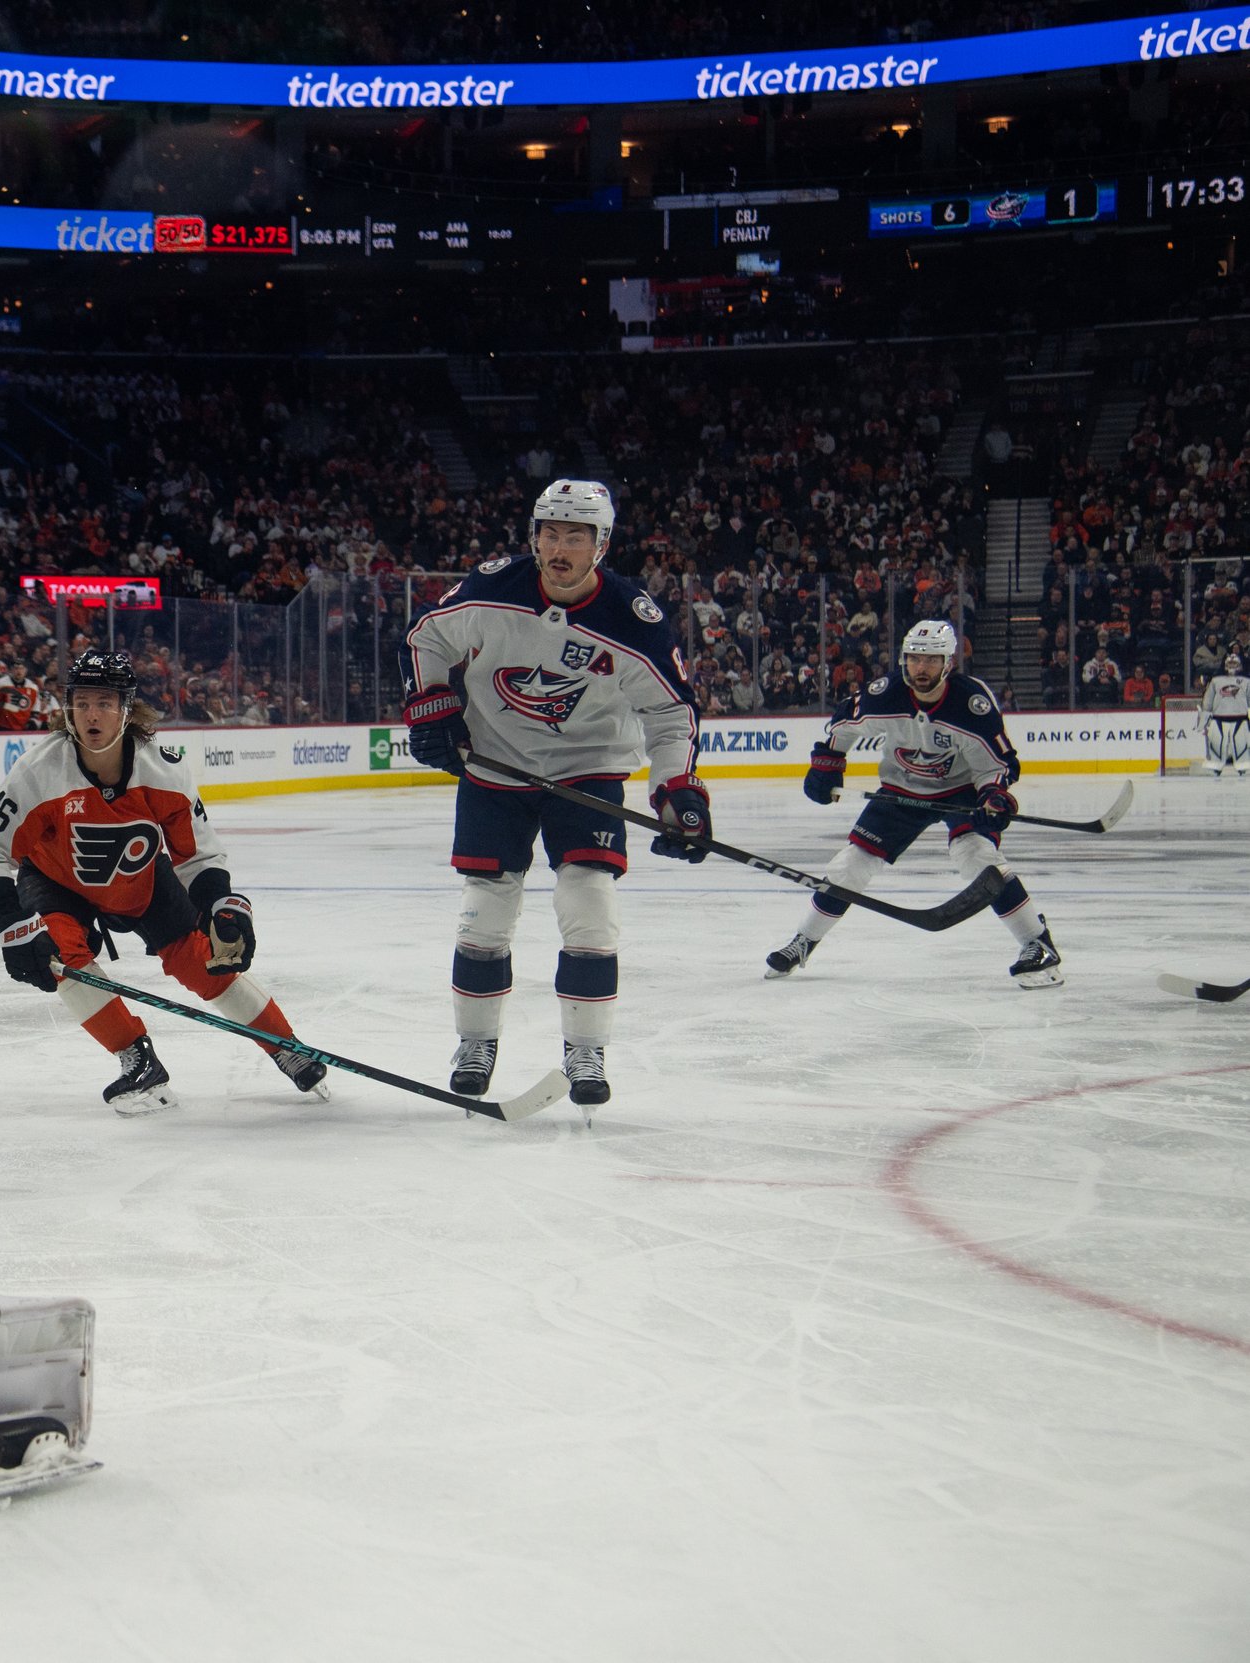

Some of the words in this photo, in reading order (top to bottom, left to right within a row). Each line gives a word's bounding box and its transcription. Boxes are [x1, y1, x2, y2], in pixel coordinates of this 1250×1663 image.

[1138, 16, 1250, 60] ticket
[696, 57, 938, 102] ticketmaster
[288, 74, 513, 109] ticketmaster
[1161, 175, 1245, 209] 17:33
[1063, 189, 1076, 217] 1
[735, 208, 758, 225] CBJ
[880, 210, 922, 225] SHOTS
[943, 203, 956, 222] 6
[211, 225, 288, 246] $21,375
[336, 229, 361, 244] PM
[446, 222, 469, 233] ANA
[722, 225, 771, 243] PENALTY
[49, 584, 111, 601] TACOMA
[917, 629, 929, 637] 19
[87, 656, 104, 666] 46
[564, 645, 591, 667] 25
[587, 650, 614, 676] A
[936, 733, 950, 746] 25
[1026, 730, 1073, 742] BANK
[1079, 730, 1100, 741] OF
[1106, 728, 1187, 740] AMERICA
[204, 746, 234, 767] Holman
[293, 739, 351, 765] ticketmaster
[64, 799, 84, 816] BX
